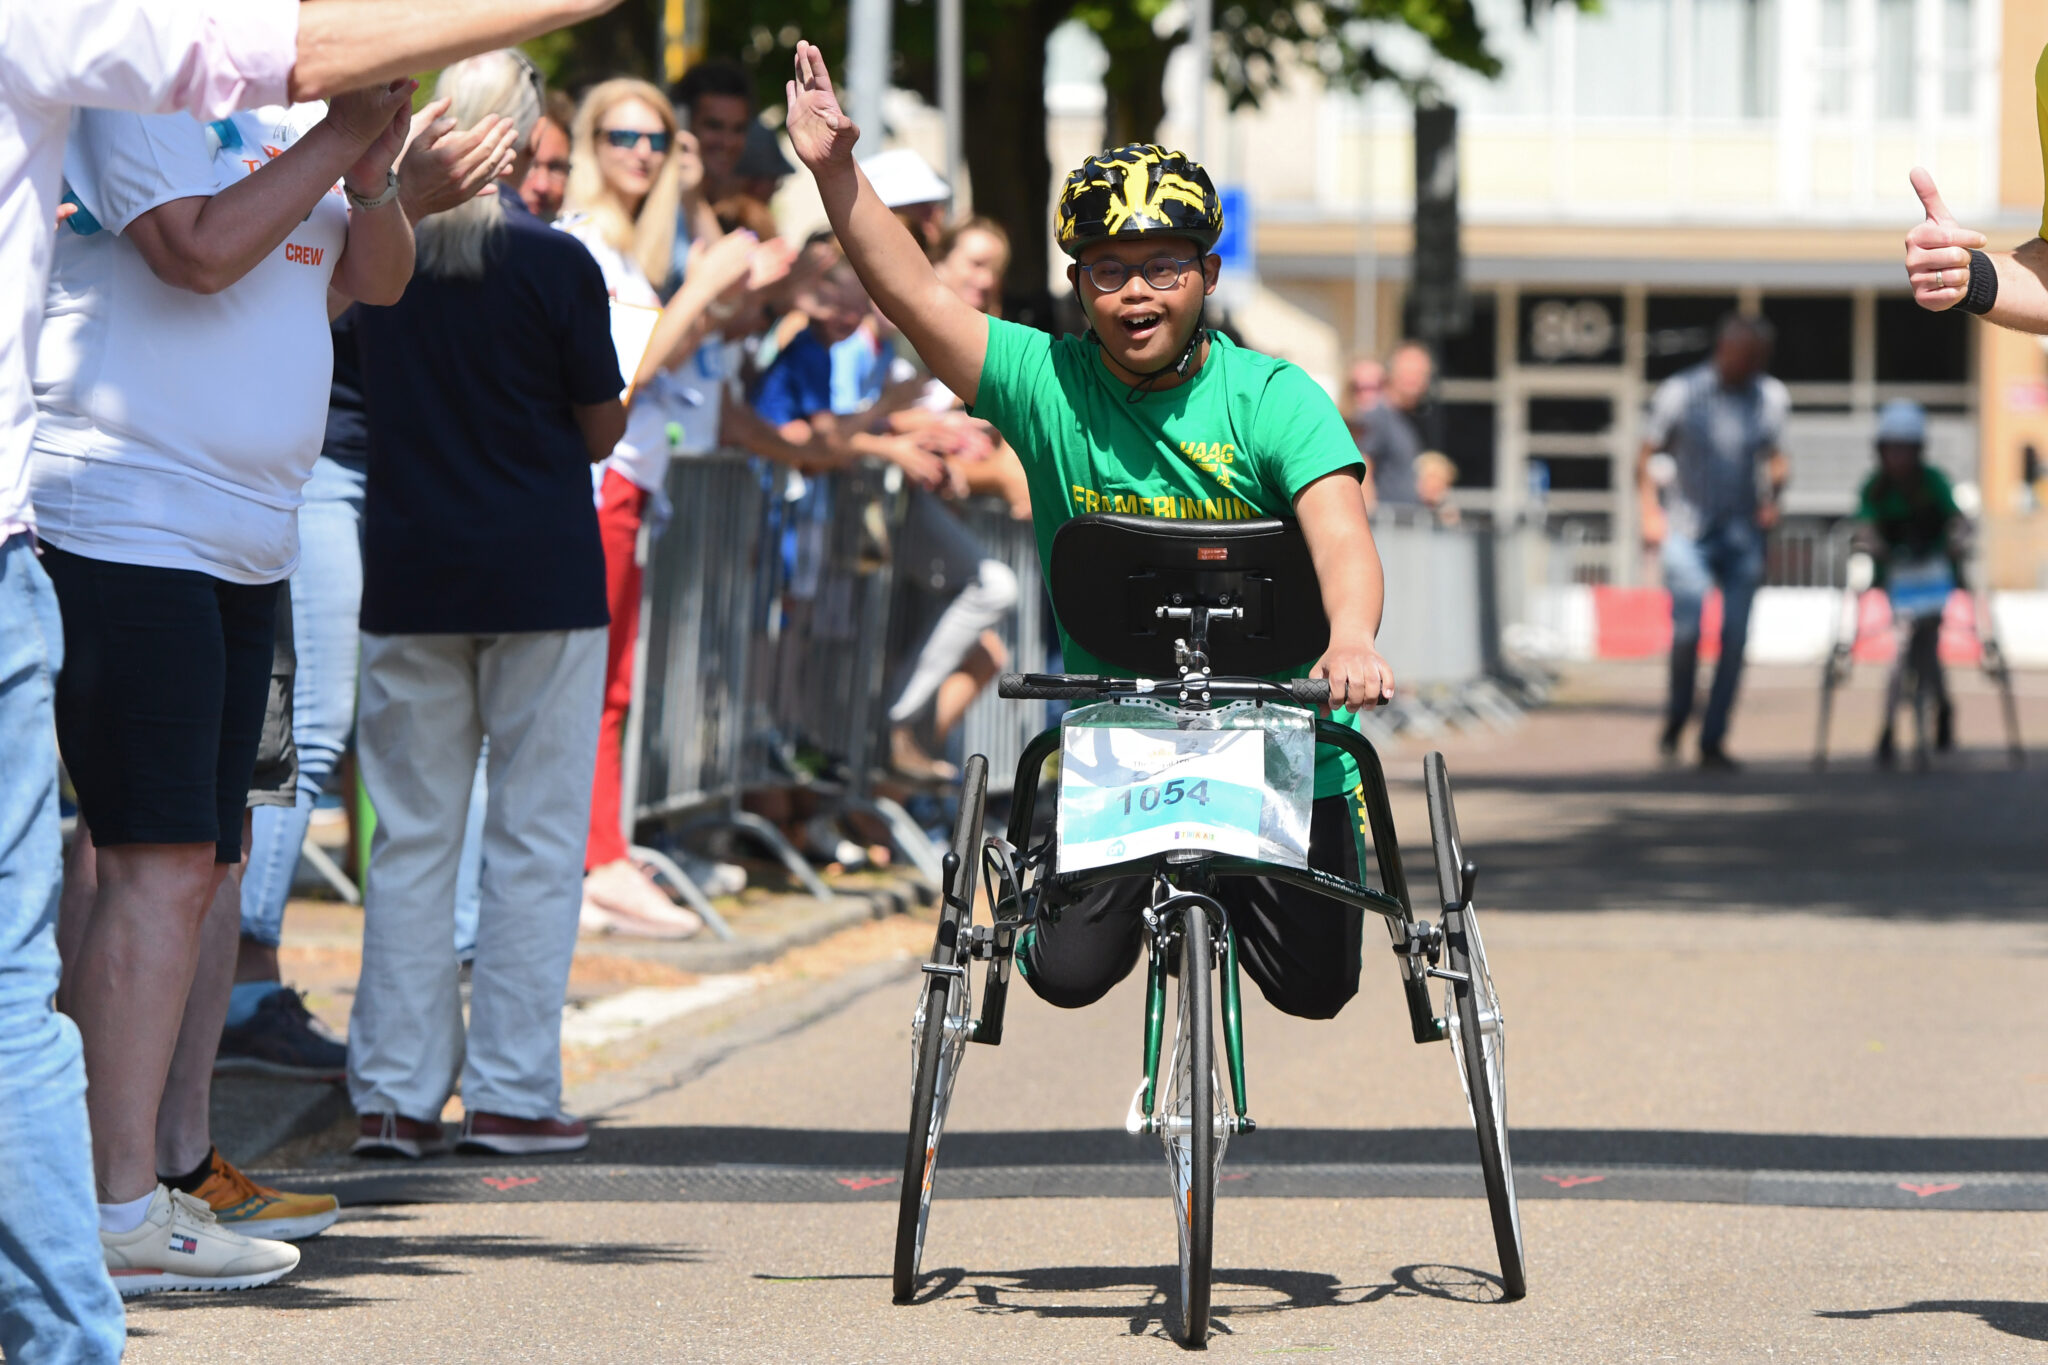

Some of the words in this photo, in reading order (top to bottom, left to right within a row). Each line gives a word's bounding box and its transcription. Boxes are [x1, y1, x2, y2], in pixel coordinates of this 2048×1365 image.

[285, 243, 324, 267] CREW
[1072, 485, 1264, 520] FRAMERUNNIN
[1117, 779, 1210, 816] 1054
